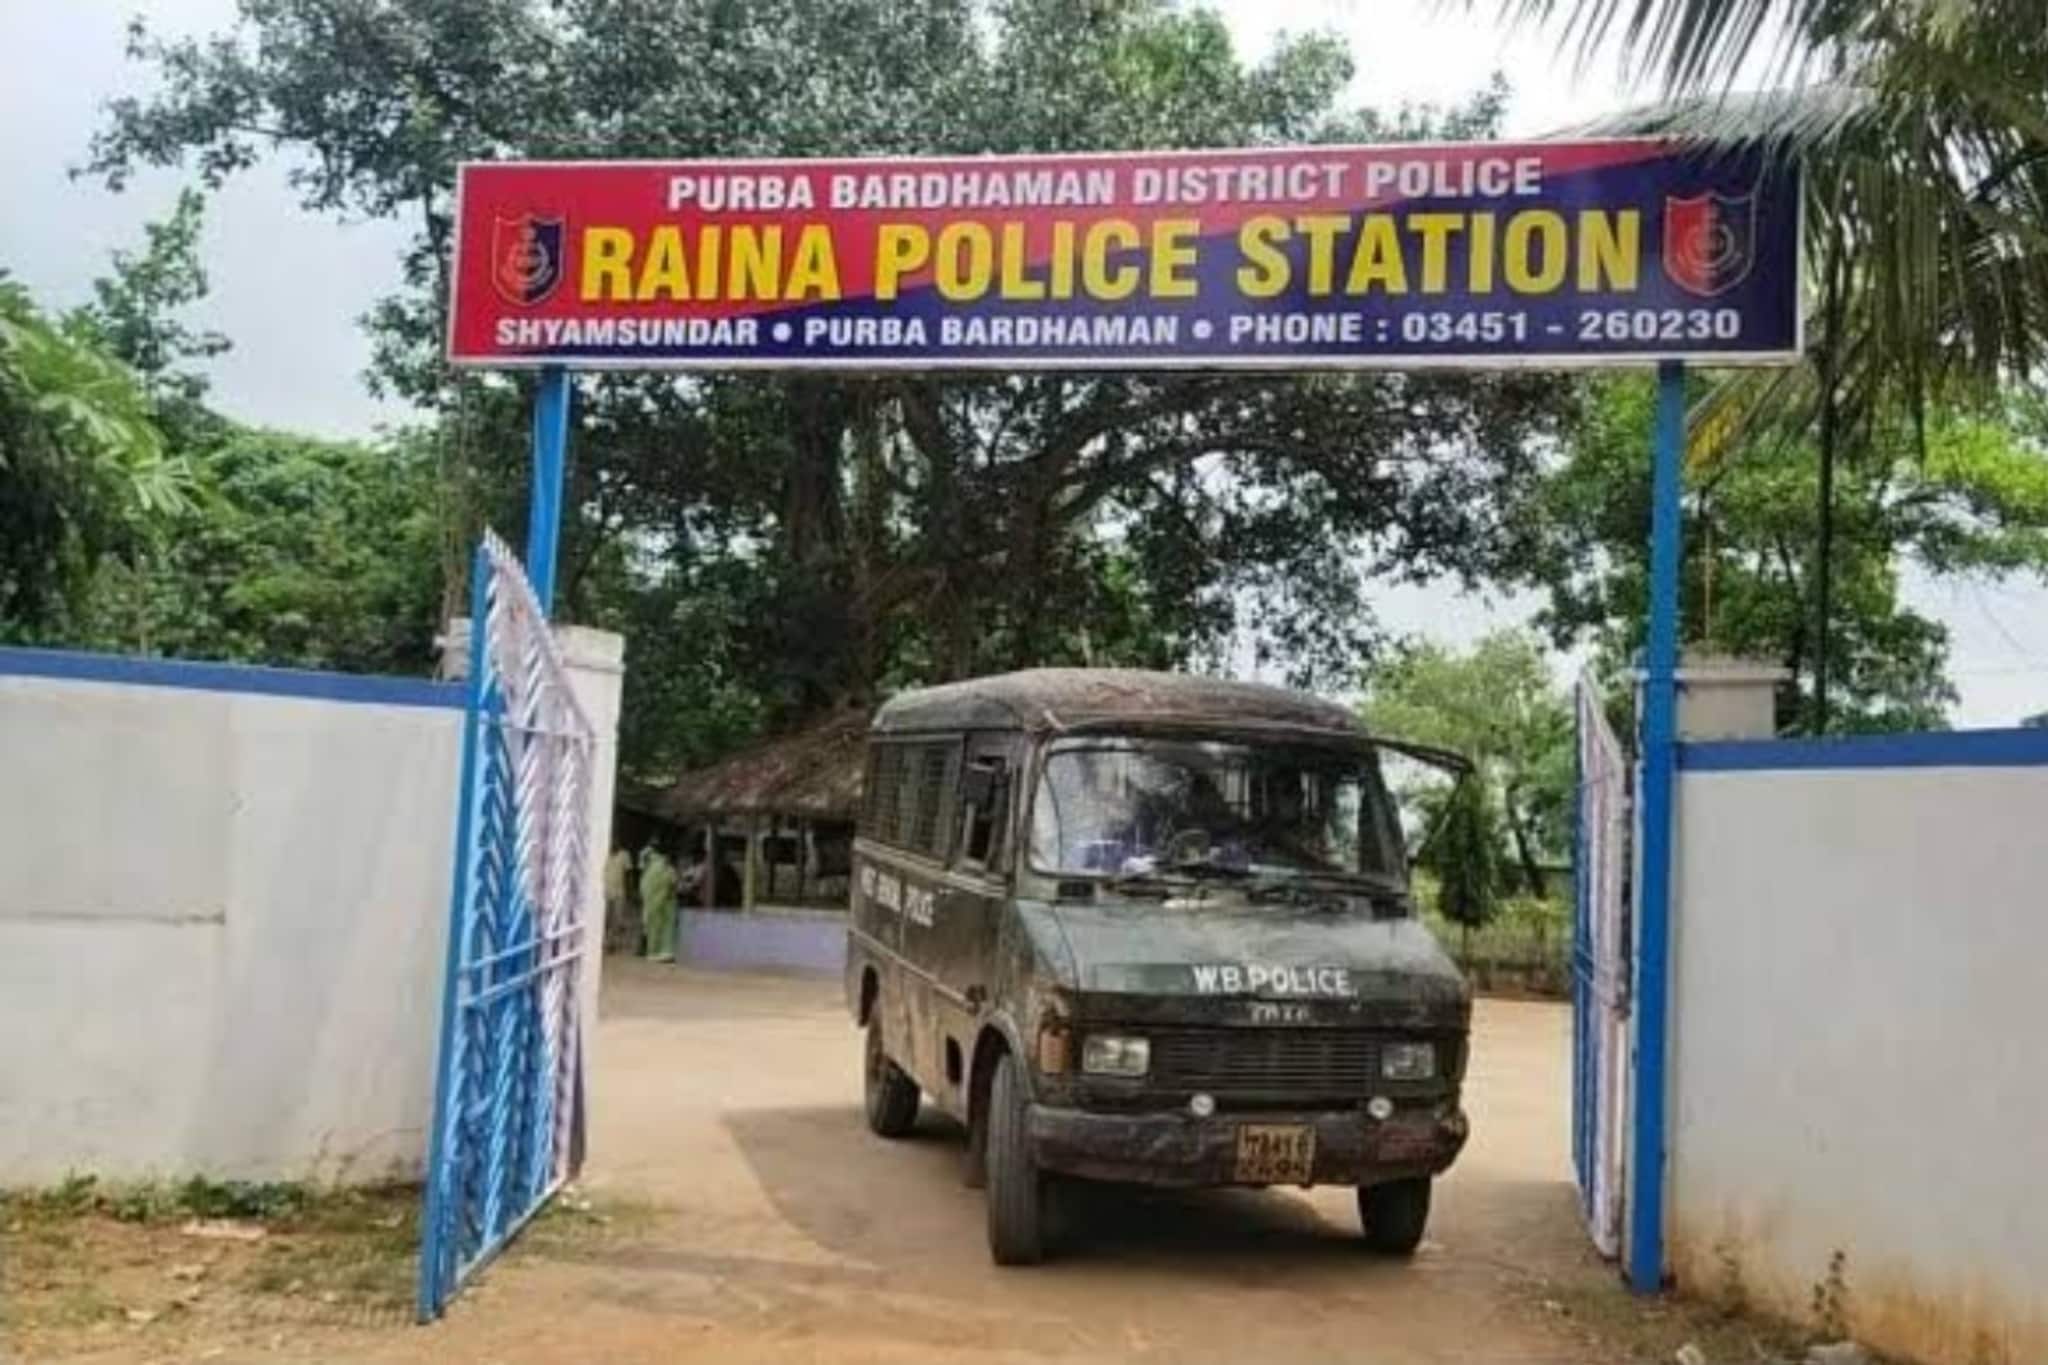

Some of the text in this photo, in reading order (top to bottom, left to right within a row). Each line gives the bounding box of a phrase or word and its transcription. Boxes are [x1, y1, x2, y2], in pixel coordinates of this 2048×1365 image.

[670, 157, 1542, 211] PURBA BARDHAMAN DISTRICT POLICE
[580, 210, 1639, 301] RAINA POLICE STATION
[496, 317, 758, 347] SHYAMSUNDAR
[804, 316, 926, 347] PURBA
[941, 316, 1179, 346] BARDHAMAN
[1230, 313, 1362, 343] PHONE
[1402, 312, 1528, 342] 03451
[1578, 309, 1740, 340] 260230
